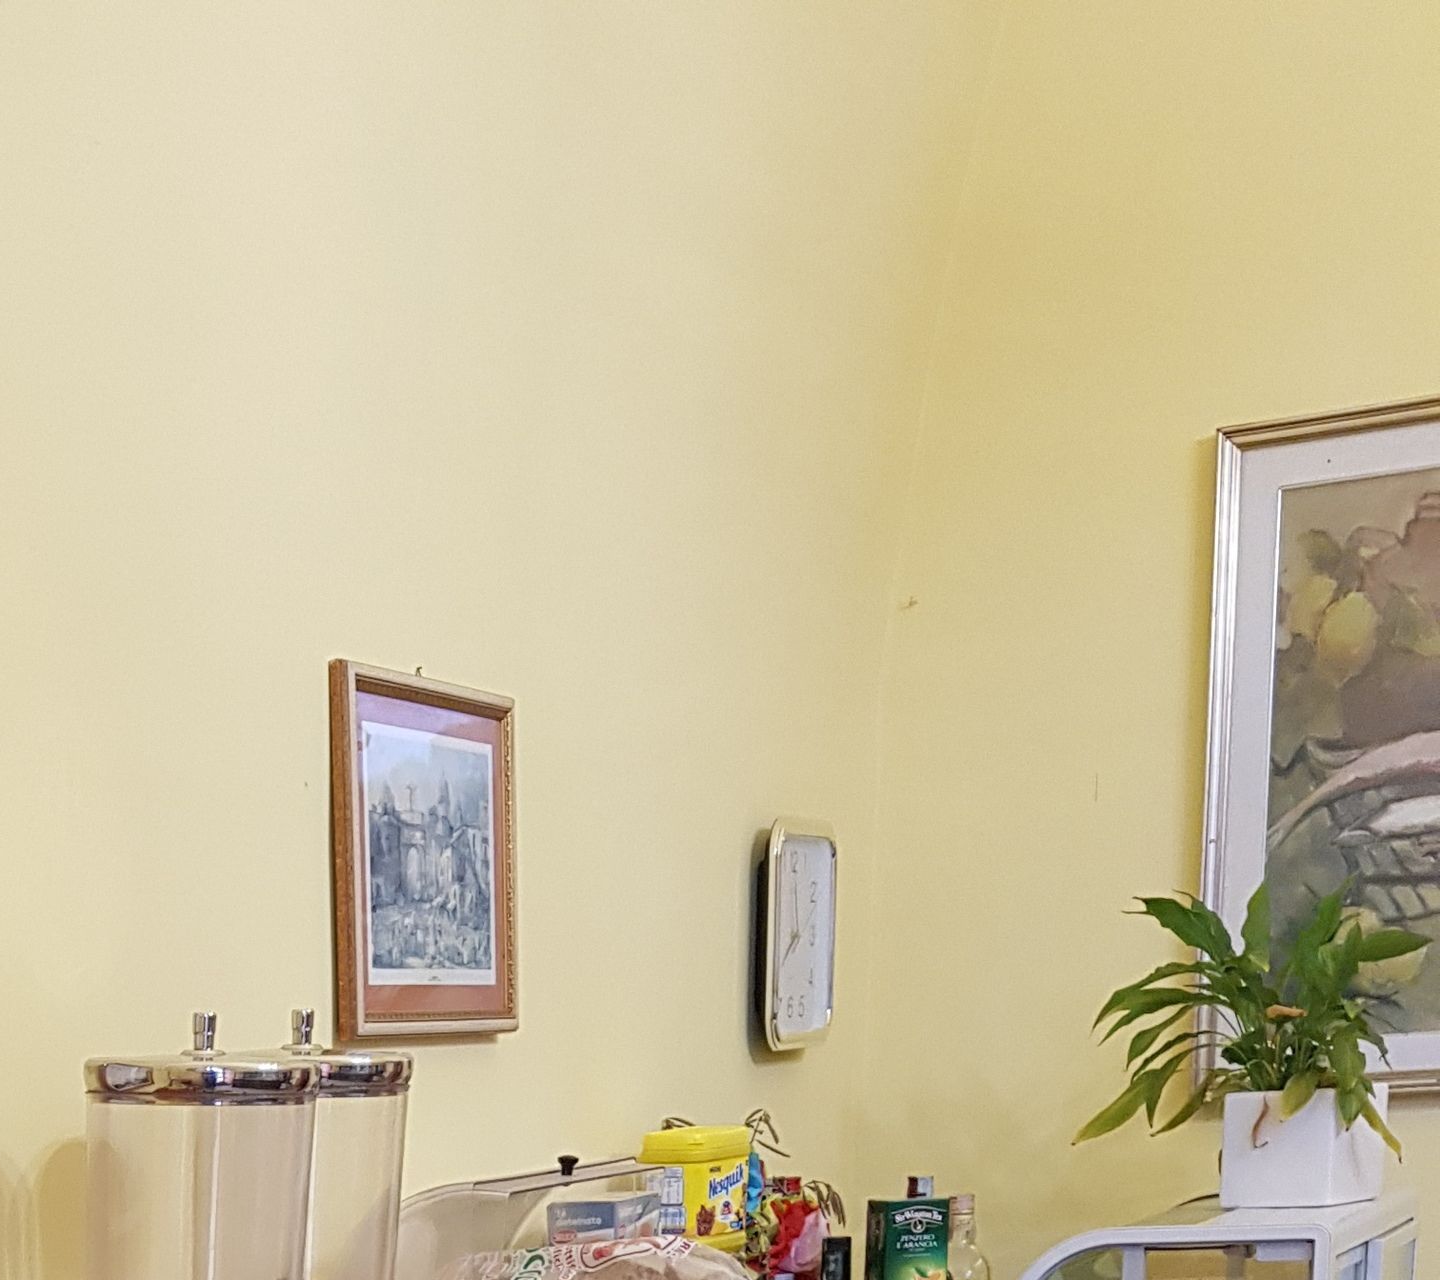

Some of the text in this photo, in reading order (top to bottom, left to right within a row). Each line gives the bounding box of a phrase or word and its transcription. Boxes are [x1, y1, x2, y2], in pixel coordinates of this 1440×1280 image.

[708, 1163, 744, 1199] Nesquik
[900, 1234, 936, 1242] ZENZERO
[903, 1241, 938, 1249] ARANCIA
